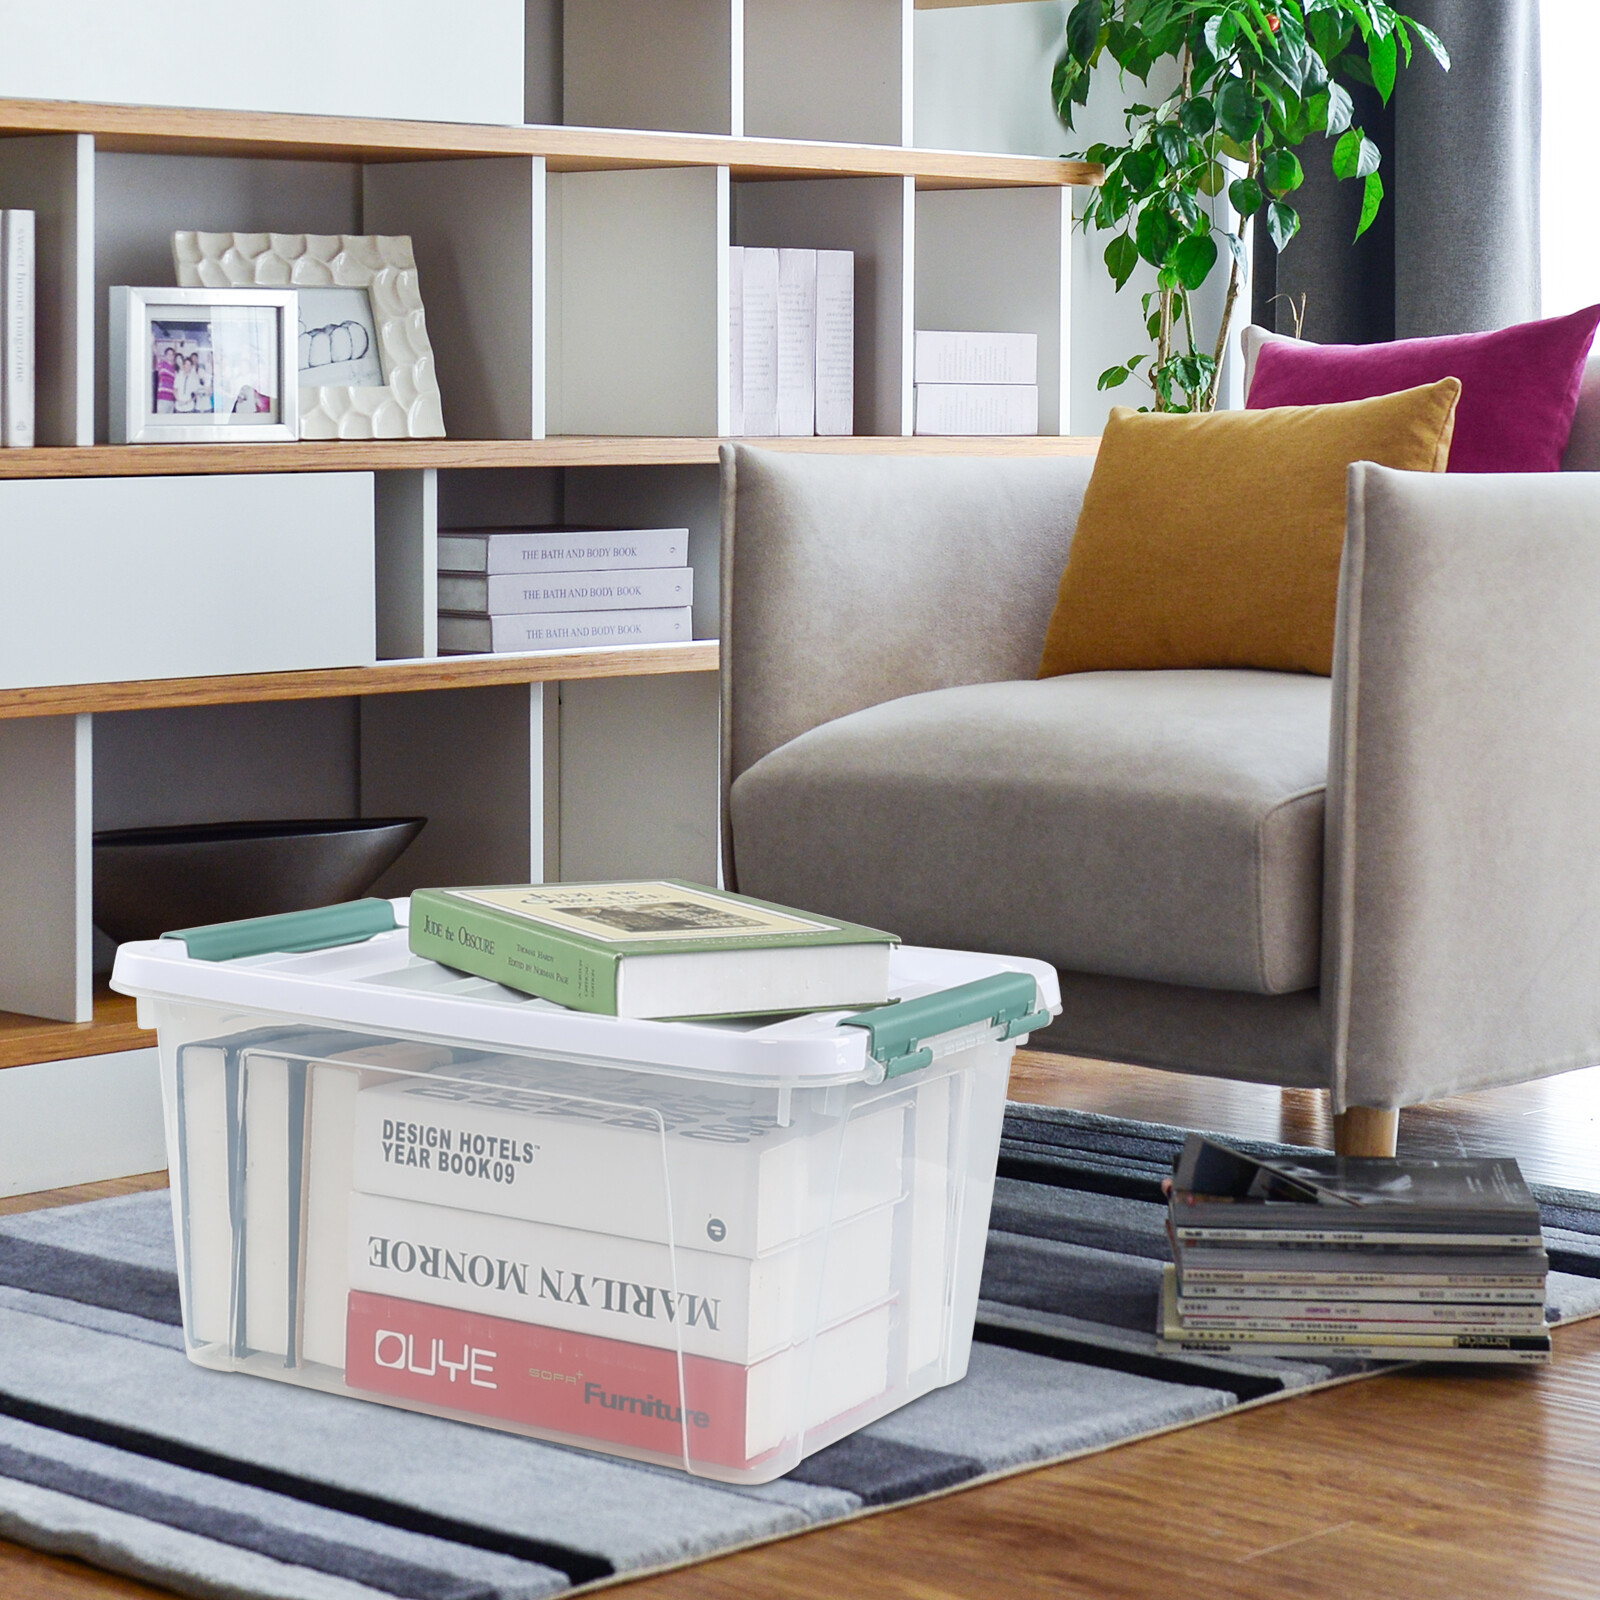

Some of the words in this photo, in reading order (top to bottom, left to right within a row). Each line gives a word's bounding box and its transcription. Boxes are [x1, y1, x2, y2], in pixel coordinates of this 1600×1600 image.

[16, 272, 27, 312] home
[14, 316, 26, 383] magazine
[521, 550, 538, 560] THE
[541, 549, 564, 559] BATH
[566, 548, 584, 558] AND
[586, 547, 611, 558] BODY
[613, 547, 637, 557] BOOK
[523, 590, 540, 600] THE
[543, 589, 566, 599] BATH
[568, 588, 588, 598] AND
[590, 587, 615, 597] BODY
[617, 586, 641, 596] BOOK
[526, 629, 543, 639] THE
[546, 628, 568, 638] BATH
[570, 627, 589, 637] AND
[592, 626, 616, 636] BODY
[618, 624, 642, 634] BOOK
[424, 915, 442, 937] JUDE
[445, 926, 454, 941] the
[458, 926, 495, 955] OBSCURE
[382, 1119, 451, 1151] DESIGN
[382, 1141, 431, 1169] YEAR
[367, 1235, 529, 1295] MONROE
[539, 1269, 722, 1331] MARILYN
[374, 1328, 498, 1390] OUYE
[584, 1381, 710, 1429] Furniture
